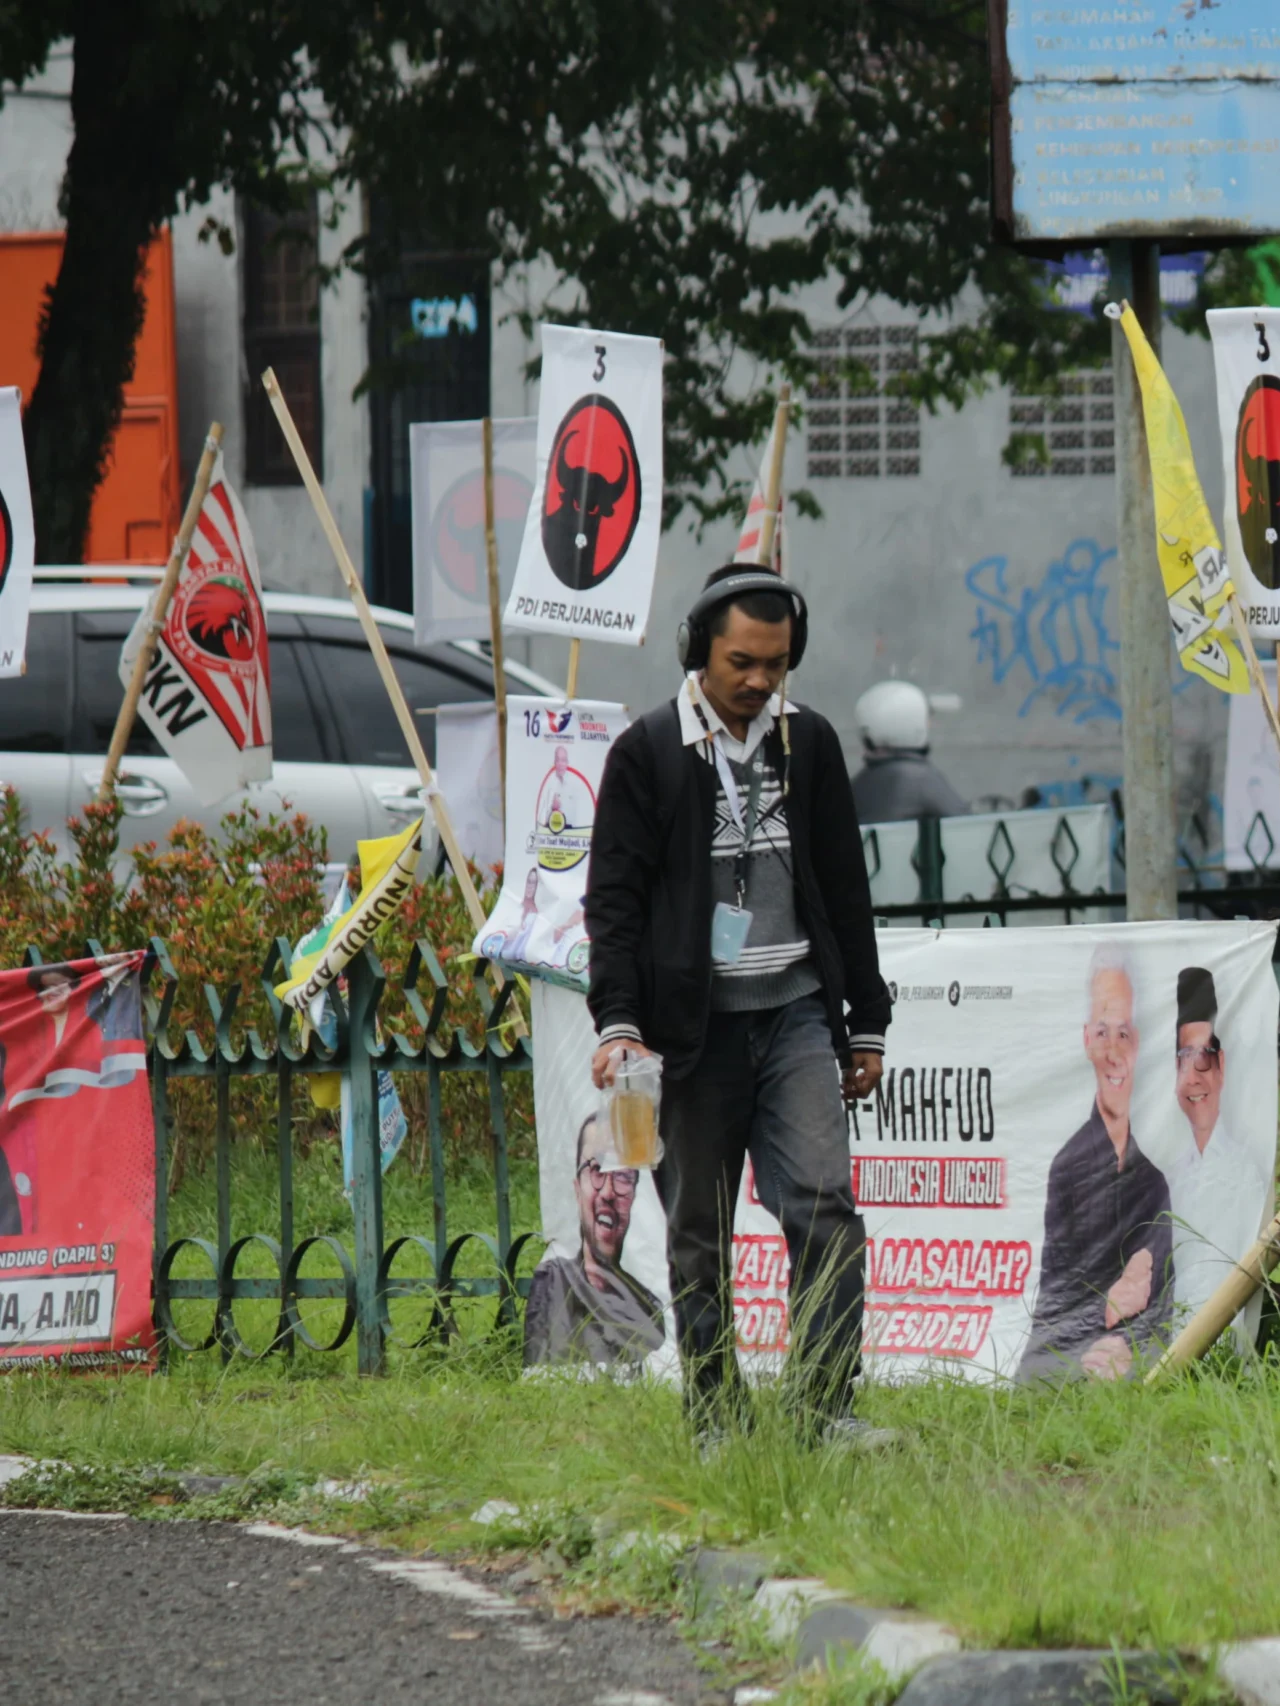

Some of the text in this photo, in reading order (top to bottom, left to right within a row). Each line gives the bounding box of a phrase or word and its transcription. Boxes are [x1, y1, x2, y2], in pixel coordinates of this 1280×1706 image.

[1254, 322, 1270, 363] 3
[592, 345, 606, 382] 3
[515, 597, 635, 632] PDI PERJUANGAN
[523, 709, 541, 739] 16
[333, 877, 409, 957] NURUL
[858, 1159, 1004, 1205] INDONESIA UNGGUL
[52, 1245, 97, 1268] (DAPIL
[101, 1243, 116, 1264] 3)
[878, 1245, 1031, 1291] MASALAH?
[35, 1288, 101, 1329] A.MD
